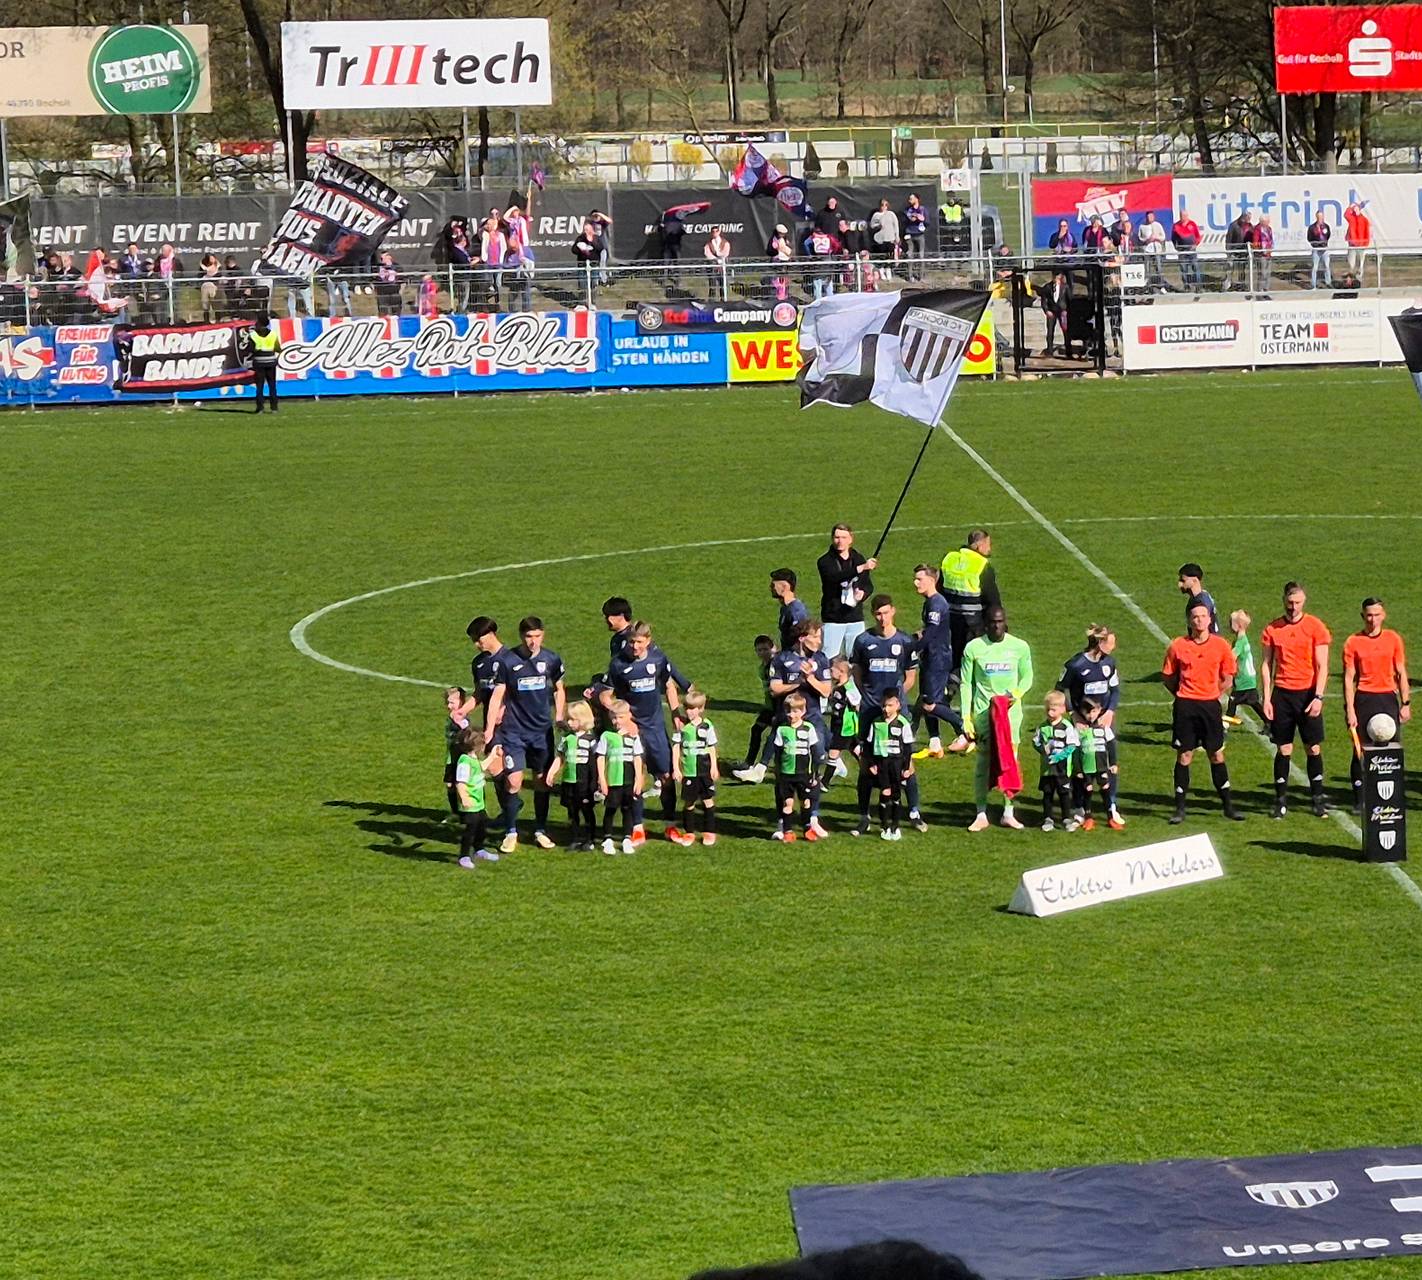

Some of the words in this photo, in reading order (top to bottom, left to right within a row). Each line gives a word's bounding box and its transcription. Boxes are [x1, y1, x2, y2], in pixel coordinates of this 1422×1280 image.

[101, 50, 183, 83] HEIM
[122, 75, 169, 92] PROFIS
[112, 223, 193, 244] EVENT
[197, 222, 262, 242] RENT
[386, 218, 432, 237] ENT
[1161, 325, 1234, 341] OSTERMANN
[1260, 323, 1310, 340] TEAM
[132, 328, 232, 357] BARMER
[278, 319, 413, 370] Allez
[614, 336, 669, 349] URLAUB
[1261, 341, 1329, 354] OSTERMANN
[71, 345, 96, 364] FÜR
[59, 366, 107, 384] ULTRAS
[144, 355, 226, 381] BANDE
[1036, 877, 1113, 903] Elektro
[1126, 853, 1215, 885] Mölders
[1222, 1236, 1391, 1257] Unsere
